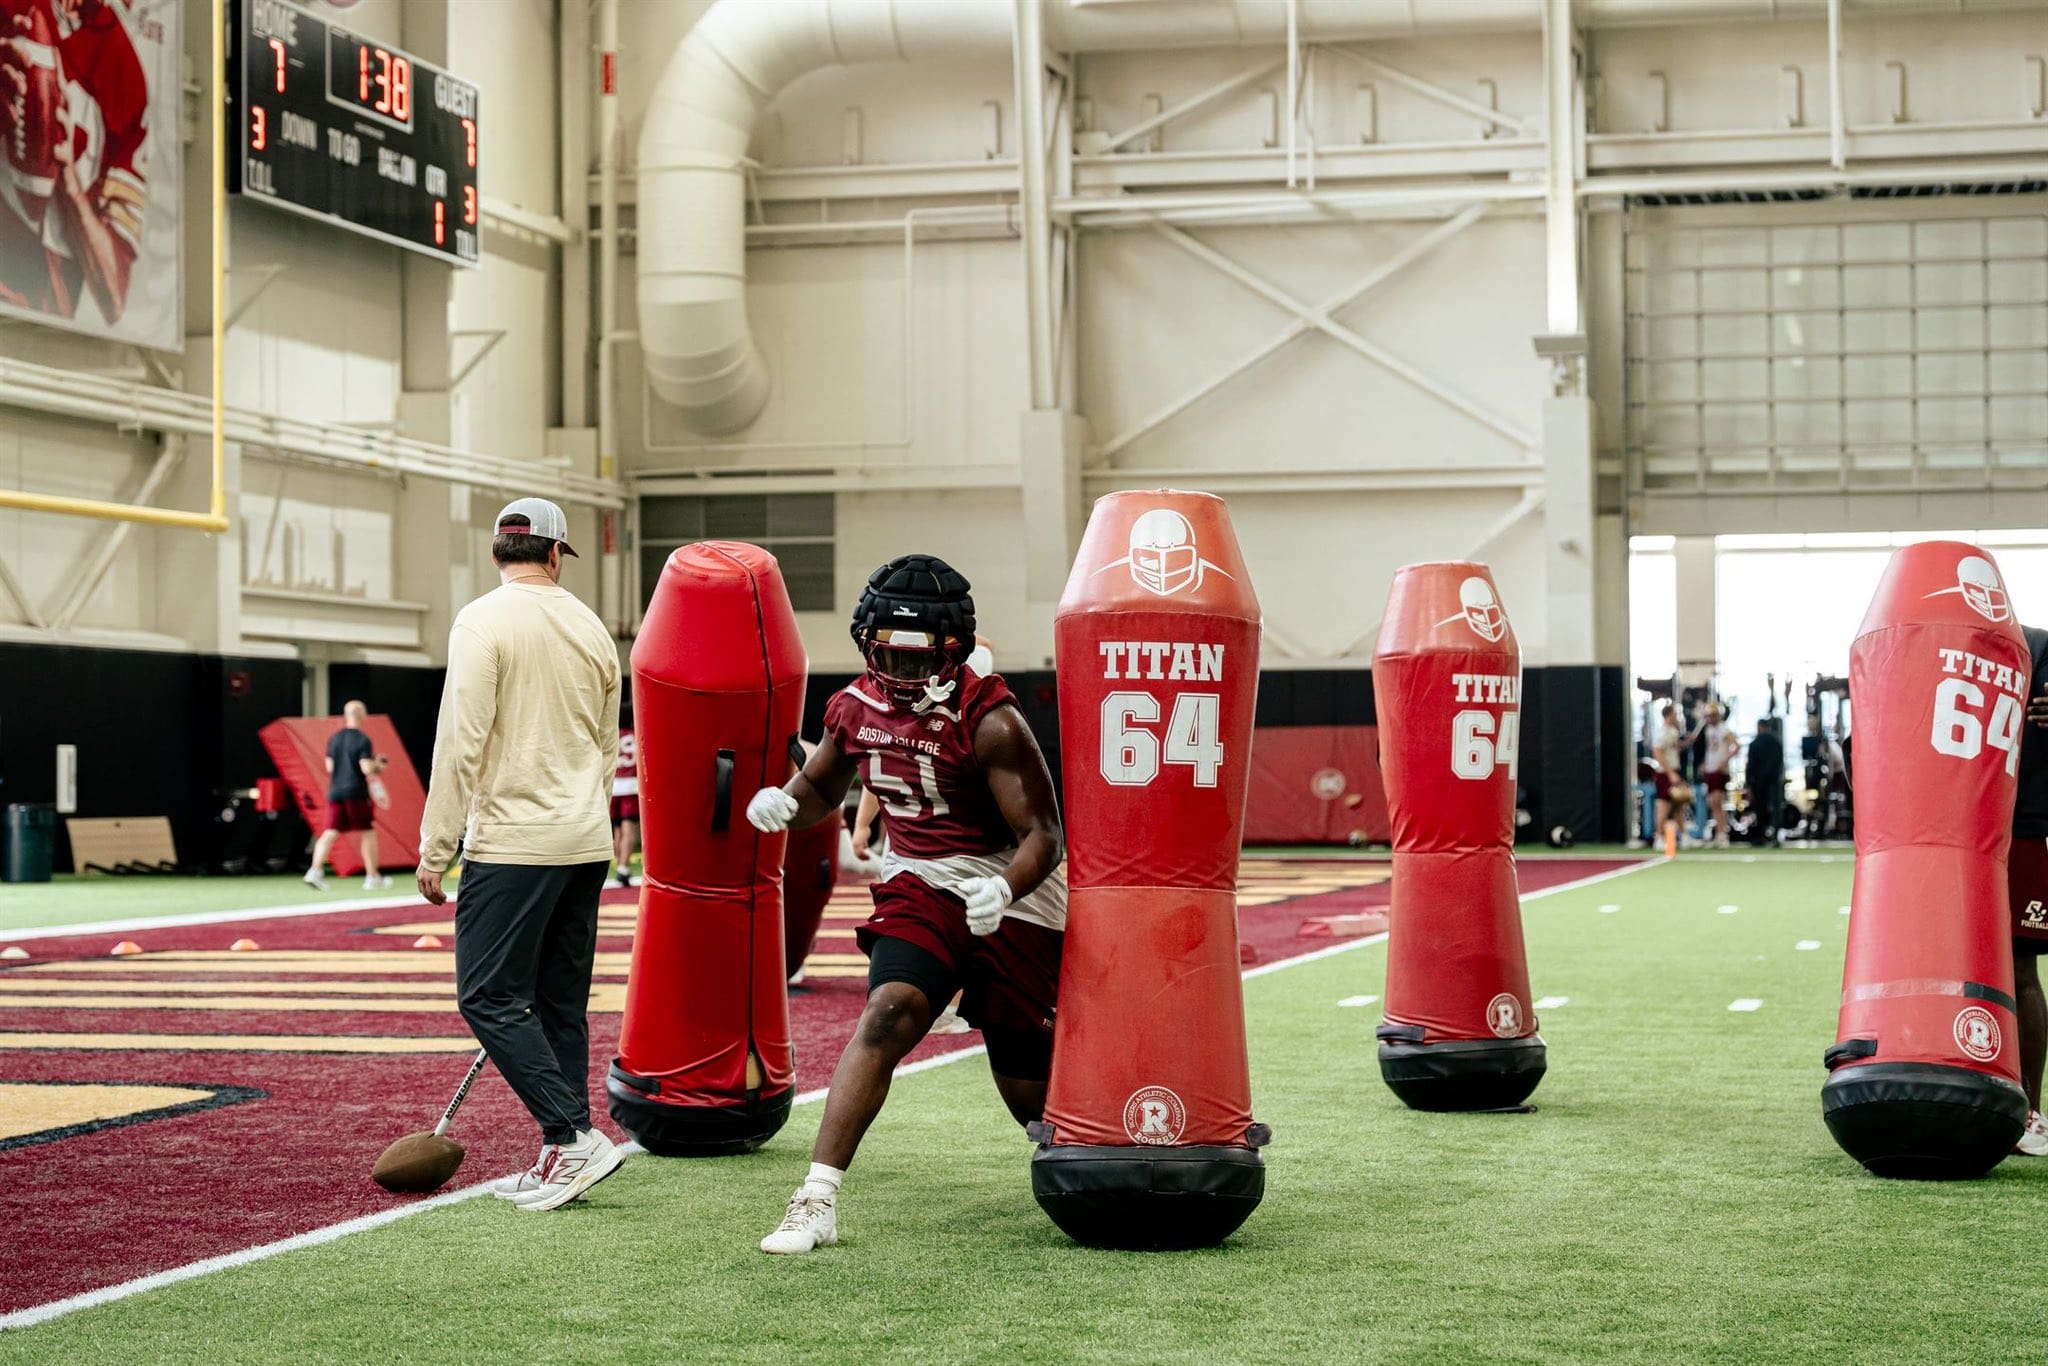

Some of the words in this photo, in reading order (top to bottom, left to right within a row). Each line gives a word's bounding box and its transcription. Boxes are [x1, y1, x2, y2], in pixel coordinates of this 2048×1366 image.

[252, 0, 298, 46] HOME
[268, 39, 286, 93] 7
[434, 73, 477, 120] GUEST
[251, 105, 267, 151] 3
[281, 110, 318, 151] DOWN
[461, 119, 477, 168] 7
[433, 200, 445, 246] 1
[463, 184, 476, 225] 3
[1100, 641, 1224, 682] TITAN
[1938, 648, 2026, 699] TITAN
[856, 726, 893, 744] BOSTON
[1100, 690, 1223, 788] 64
[1451, 709, 1519, 780] 64
[1931, 677, 2024, 778] 64
[867, 748, 950, 818] 51
[1136, 1090, 1167, 1103] ATHLETIC
[1166, 1095, 1182, 1129] COMPANY
[1140, 1100, 1169, 1133] R
[1134, 1132, 1175, 1145] ROGERS
